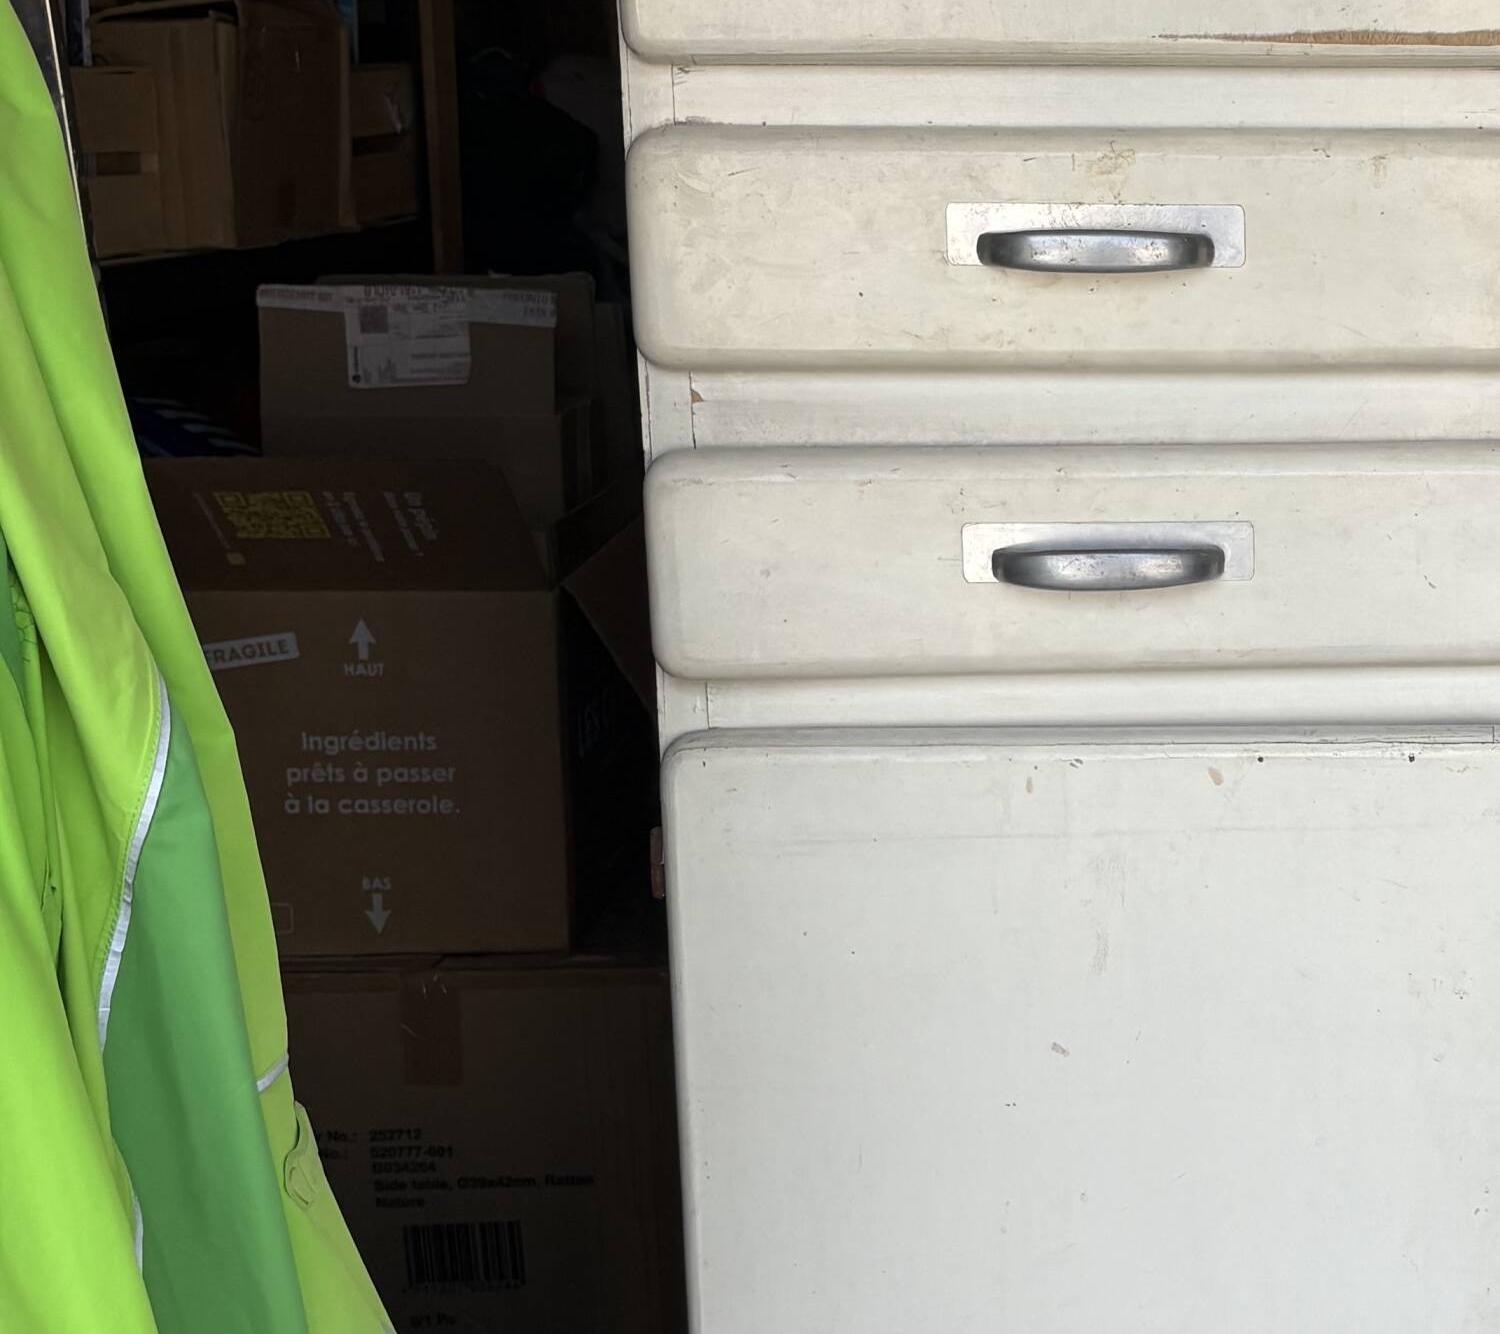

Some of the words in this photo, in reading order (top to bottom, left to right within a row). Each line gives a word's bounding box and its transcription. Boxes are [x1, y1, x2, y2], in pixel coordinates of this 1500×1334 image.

[343, 663, 384, 677] HAUT
[301, 730, 437, 755] Ingrédients
[286, 762, 345, 786] prêts
[353, 761, 369, 782] à
[376, 764, 456, 786] passer
[284, 792, 300, 814] à
[308, 795, 330, 814] la
[337, 795, 461, 814] casserole.
[362, 876, 392, 891] BAS
